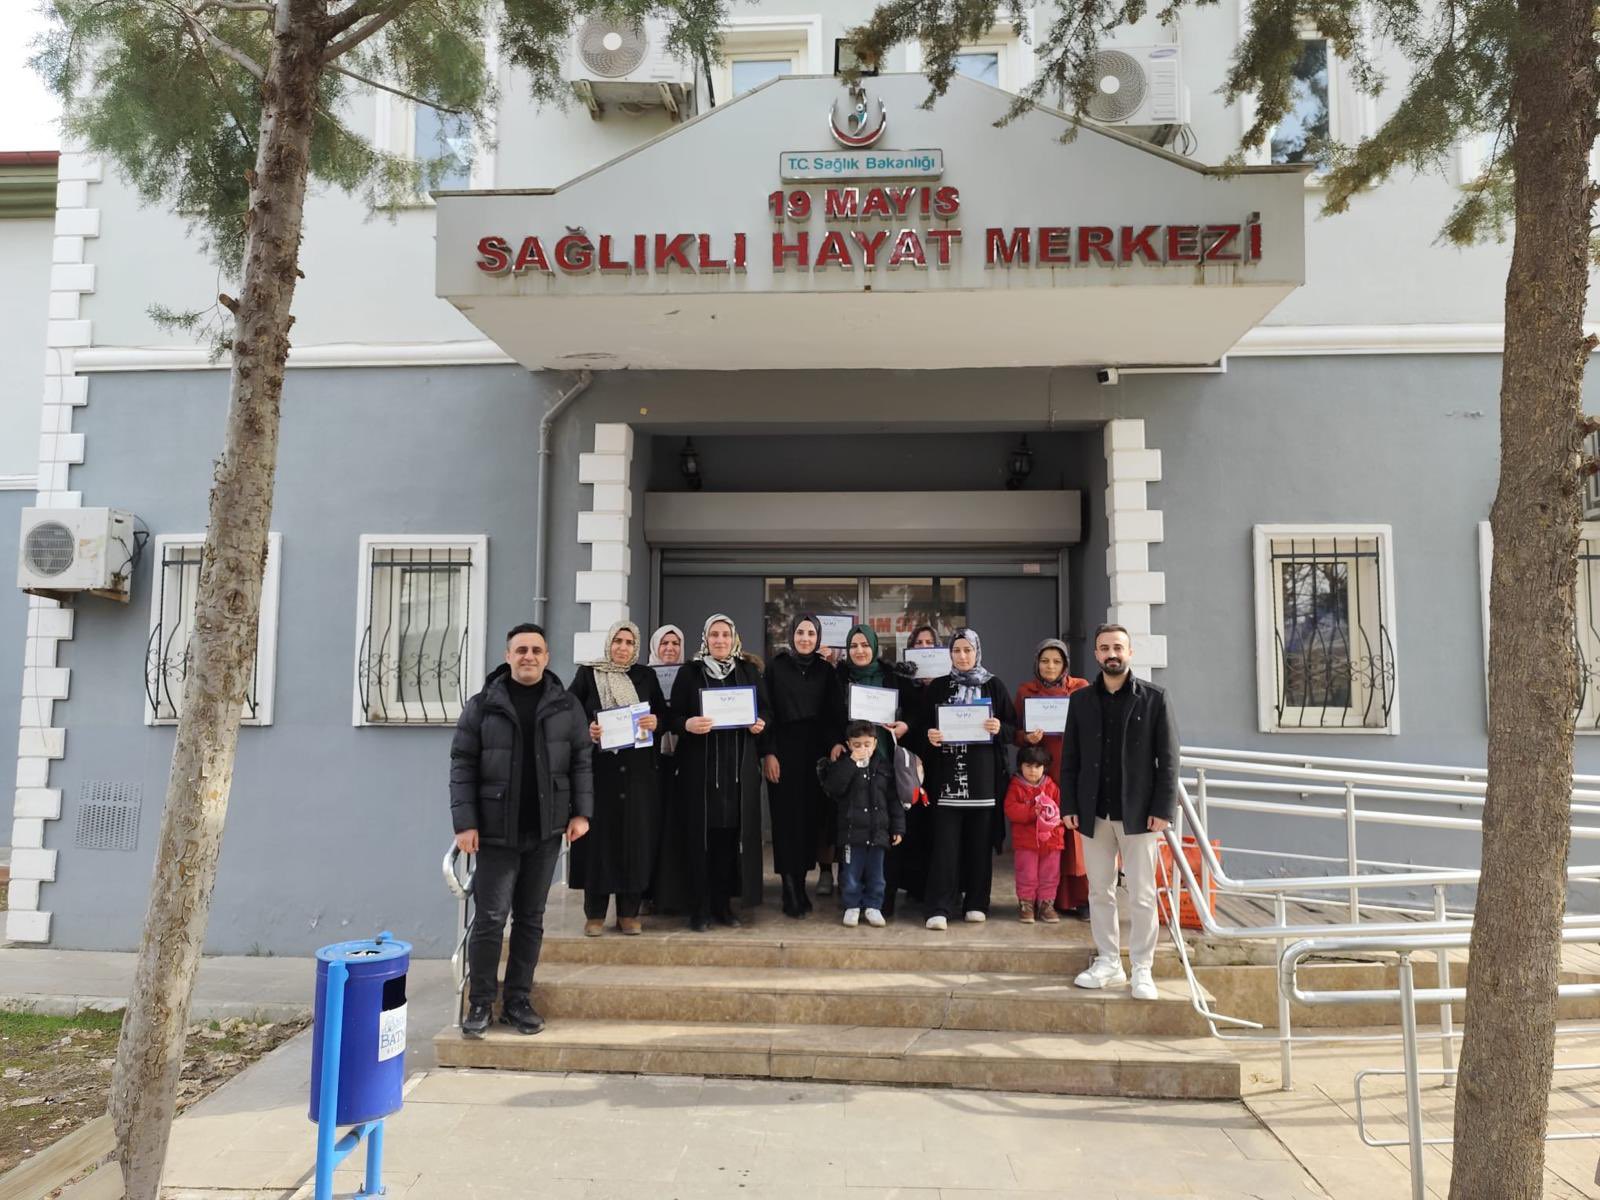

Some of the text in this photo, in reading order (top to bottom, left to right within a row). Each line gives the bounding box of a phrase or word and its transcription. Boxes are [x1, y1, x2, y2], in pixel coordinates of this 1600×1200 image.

[814, 157, 860, 173] Sağlık
[866, 155, 935, 171] Bakanlığı
[768, 186, 961, 221] 19 MAYIS
[476, 211, 1262, 277] SAĞLIKLI HAYAT MERKEZİ
